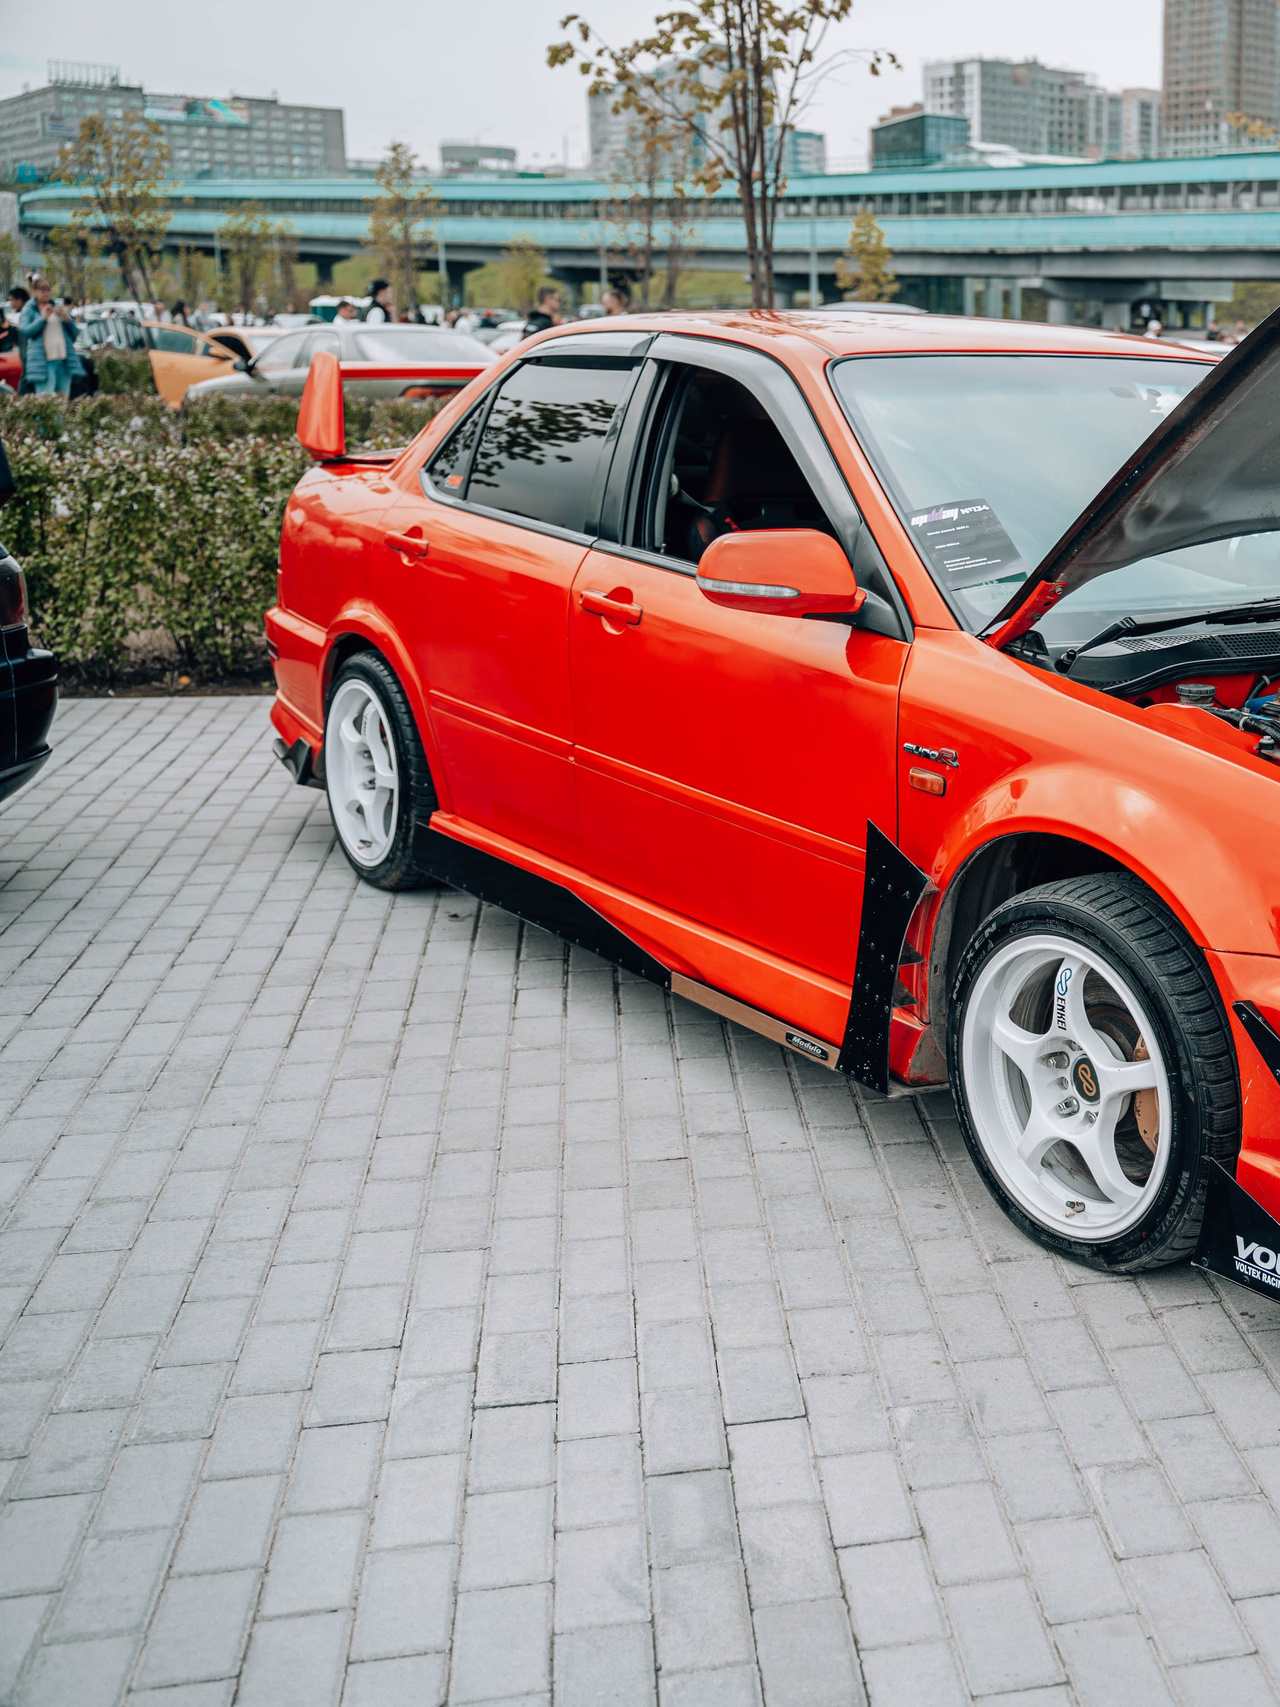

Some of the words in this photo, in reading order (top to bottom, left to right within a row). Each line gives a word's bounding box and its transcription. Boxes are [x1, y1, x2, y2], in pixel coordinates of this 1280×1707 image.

[952, 921, 997, 1000] NEXEN
[1056, 997, 1067, 1031] ENKEI
[792, 1036, 822, 1054] Modulo
[1235, 1261, 1262, 1280] VOLTEX
